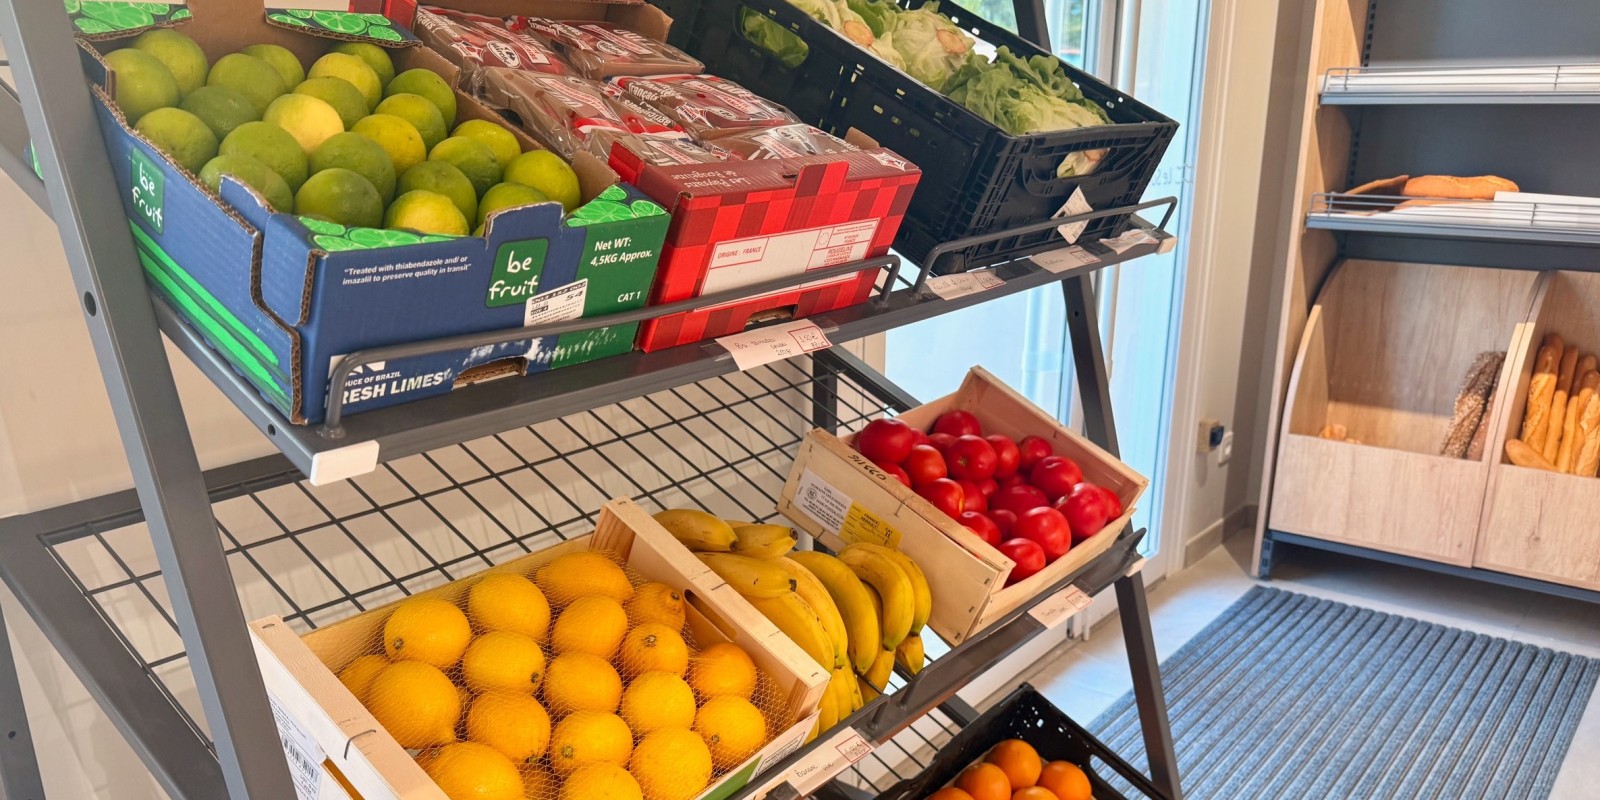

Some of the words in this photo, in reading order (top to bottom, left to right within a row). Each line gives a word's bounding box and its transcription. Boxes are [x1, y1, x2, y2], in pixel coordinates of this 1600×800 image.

[139, 162, 155, 195] be
[131, 185, 163, 228] fruit
[594, 240, 611, 251] Net
[613, 237, 632, 249] WT:
[717, 249, 738, 259] ORIGINE
[742, 246, 762, 255] FRANCE
[378, 264, 394, 274] with
[395, 258, 443, 271] thiabendazole
[506, 250, 532, 273] be
[590, 254, 618, 267] 4,5KG
[618, 250, 653, 264] Approx.
[342, 274, 372, 285] imazalil
[382, 271, 414, 282] preserve
[414, 267, 438, 278] quality
[439, 266, 446, 274] in
[489, 275, 538, 301] fruit
[617, 291, 634, 303] CAT
[636, 290, 642, 300] 1
[364, 376, 375, 384] OF
[375, 371, 401, 381] BRAZIL
[342, 383, 386, 405] RESH
